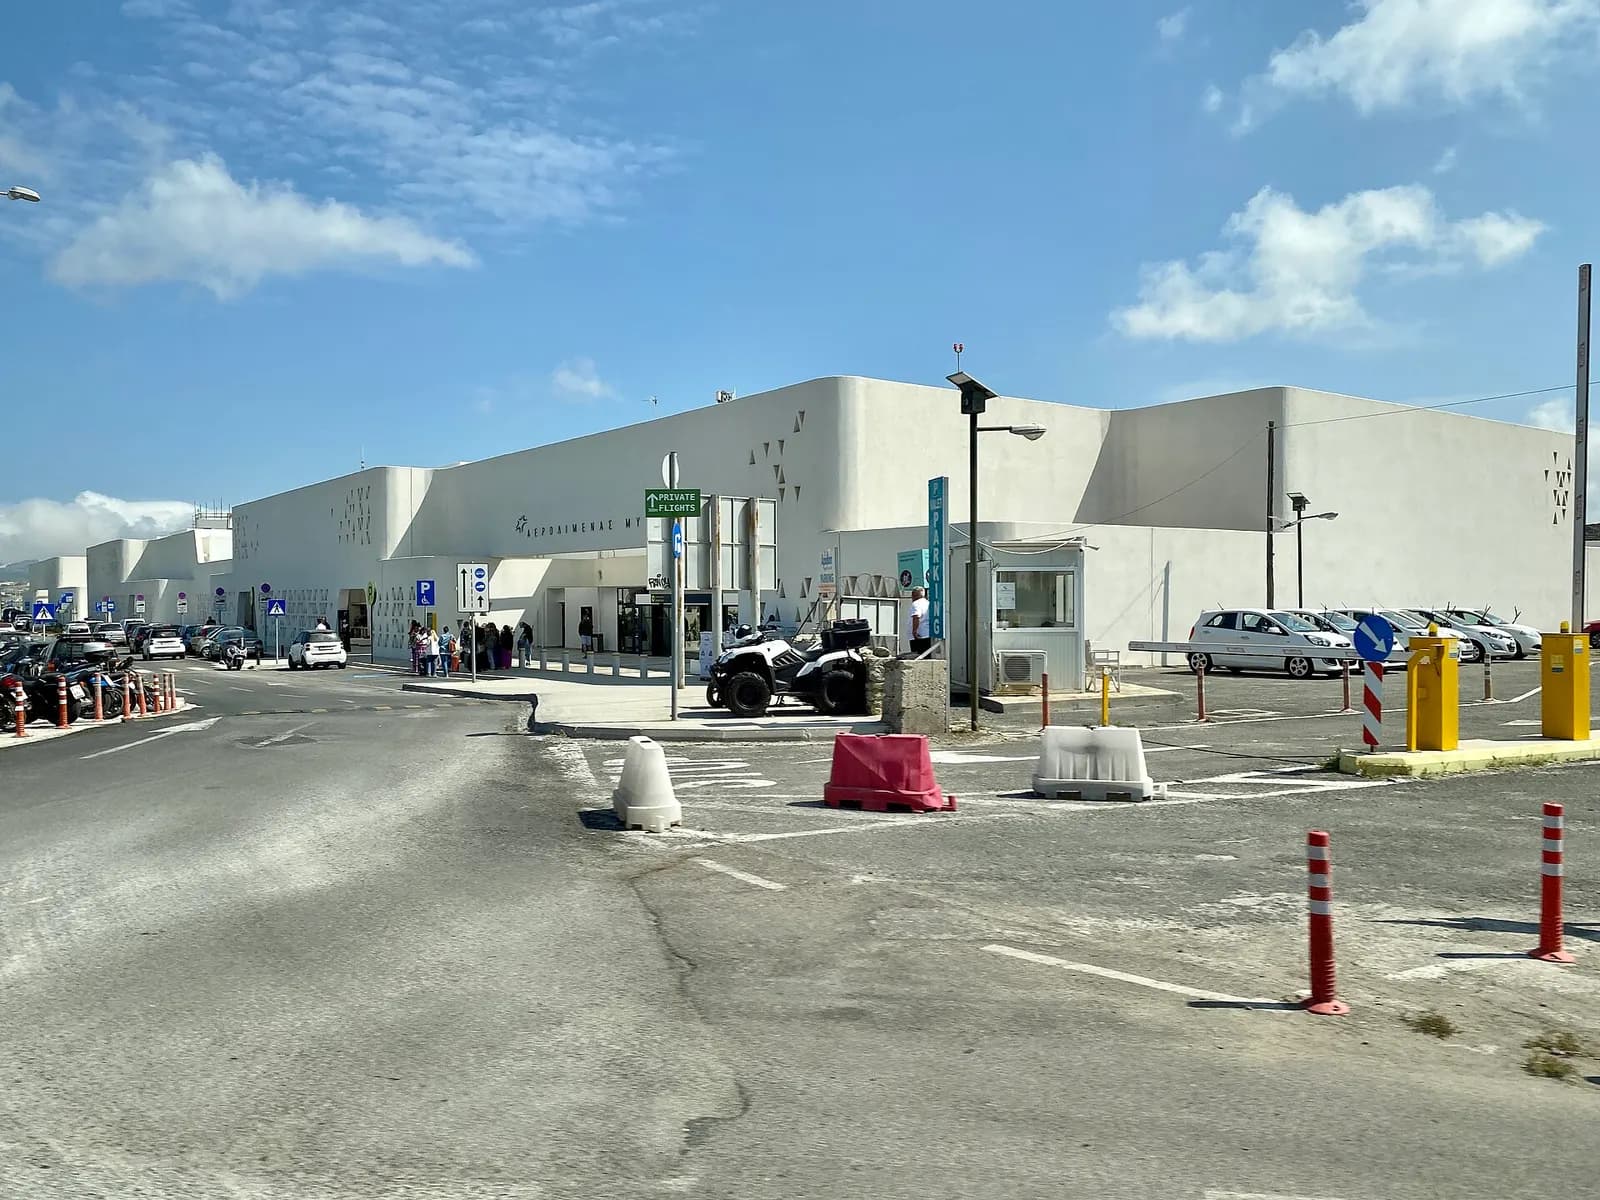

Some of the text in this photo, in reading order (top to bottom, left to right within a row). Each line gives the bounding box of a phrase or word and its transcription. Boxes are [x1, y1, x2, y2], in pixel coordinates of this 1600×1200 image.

[658, 493, 695, 501] PRIVATE
[658, 504, 696, 512] FLIGHTS
[932, 512, 941, 635] PARKING
[421, 582, 430, 594] P
